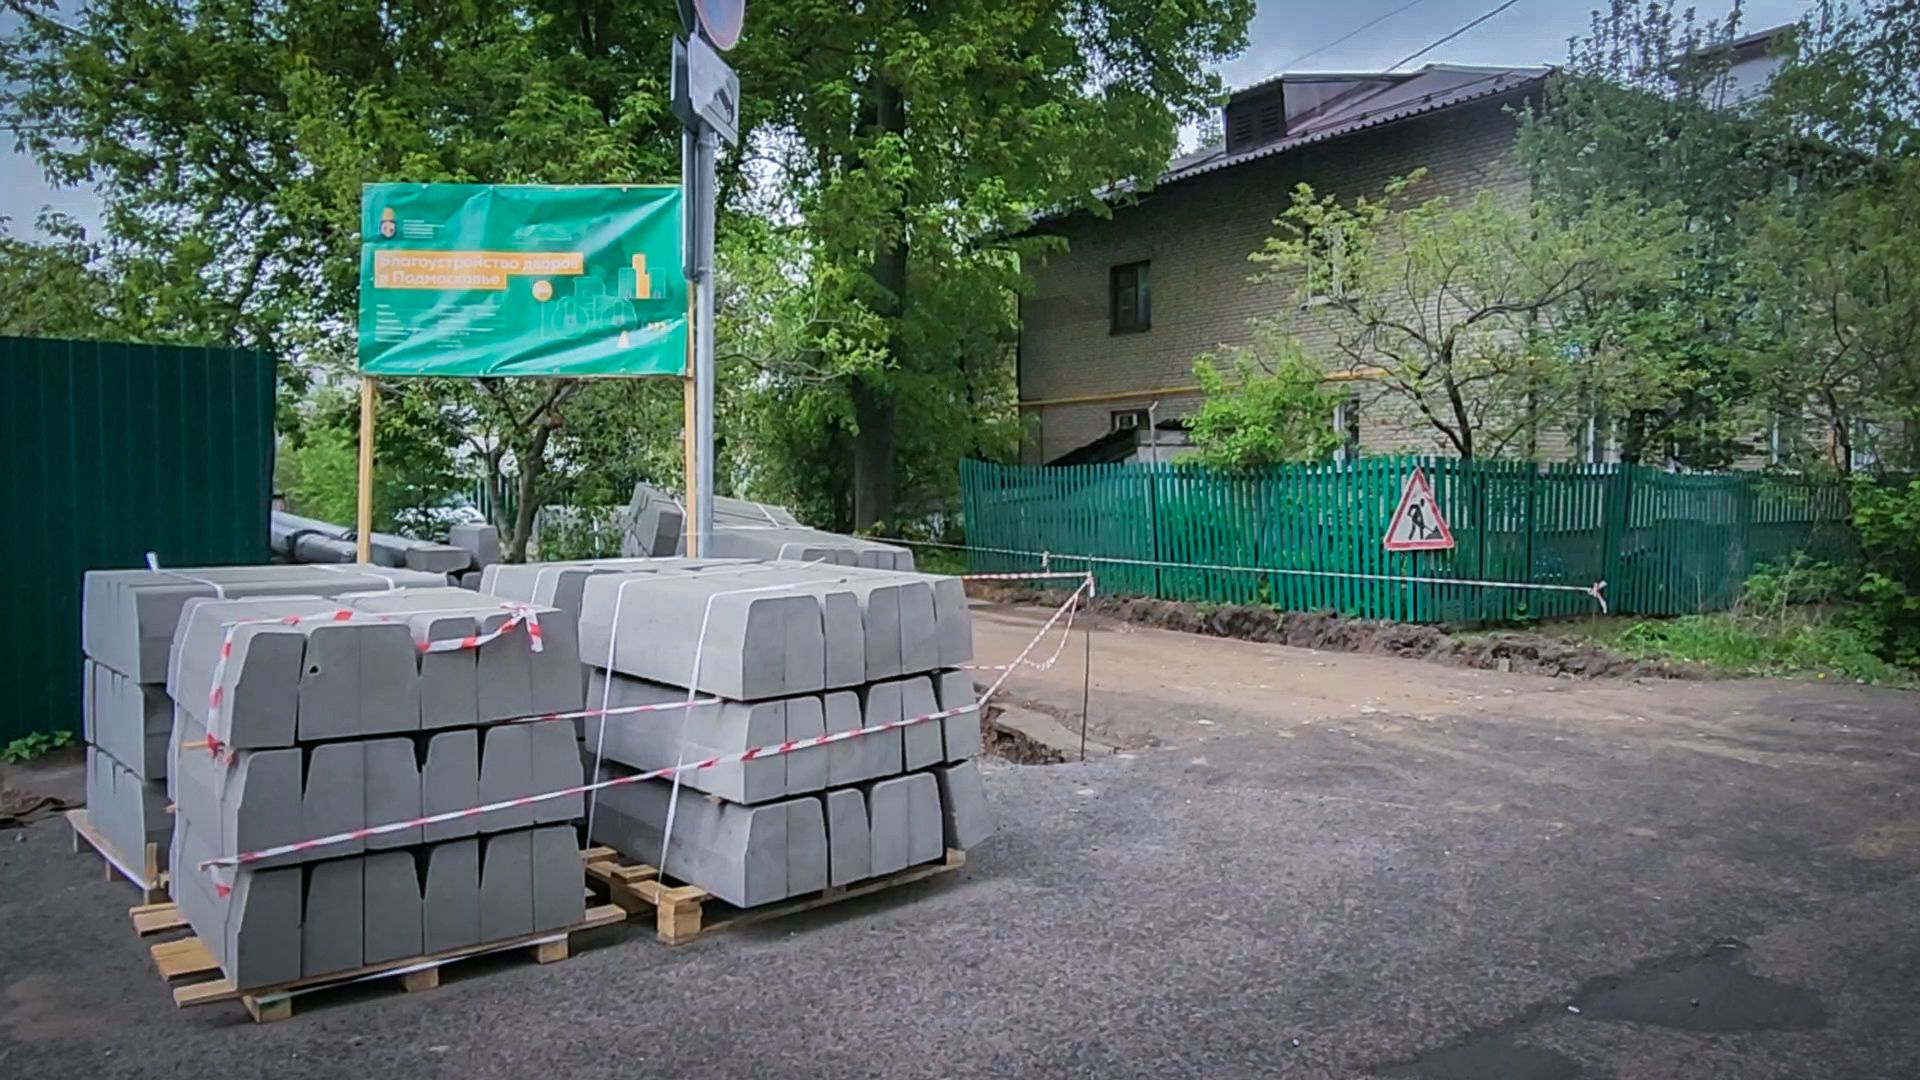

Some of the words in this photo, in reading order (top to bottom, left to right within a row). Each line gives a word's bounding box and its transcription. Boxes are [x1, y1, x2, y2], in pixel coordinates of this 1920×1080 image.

[380, 255, 519, 270] Благоустройство
[523, 258, 579, 272] дворов
[393, 270, 501, 284] Подмосковье
